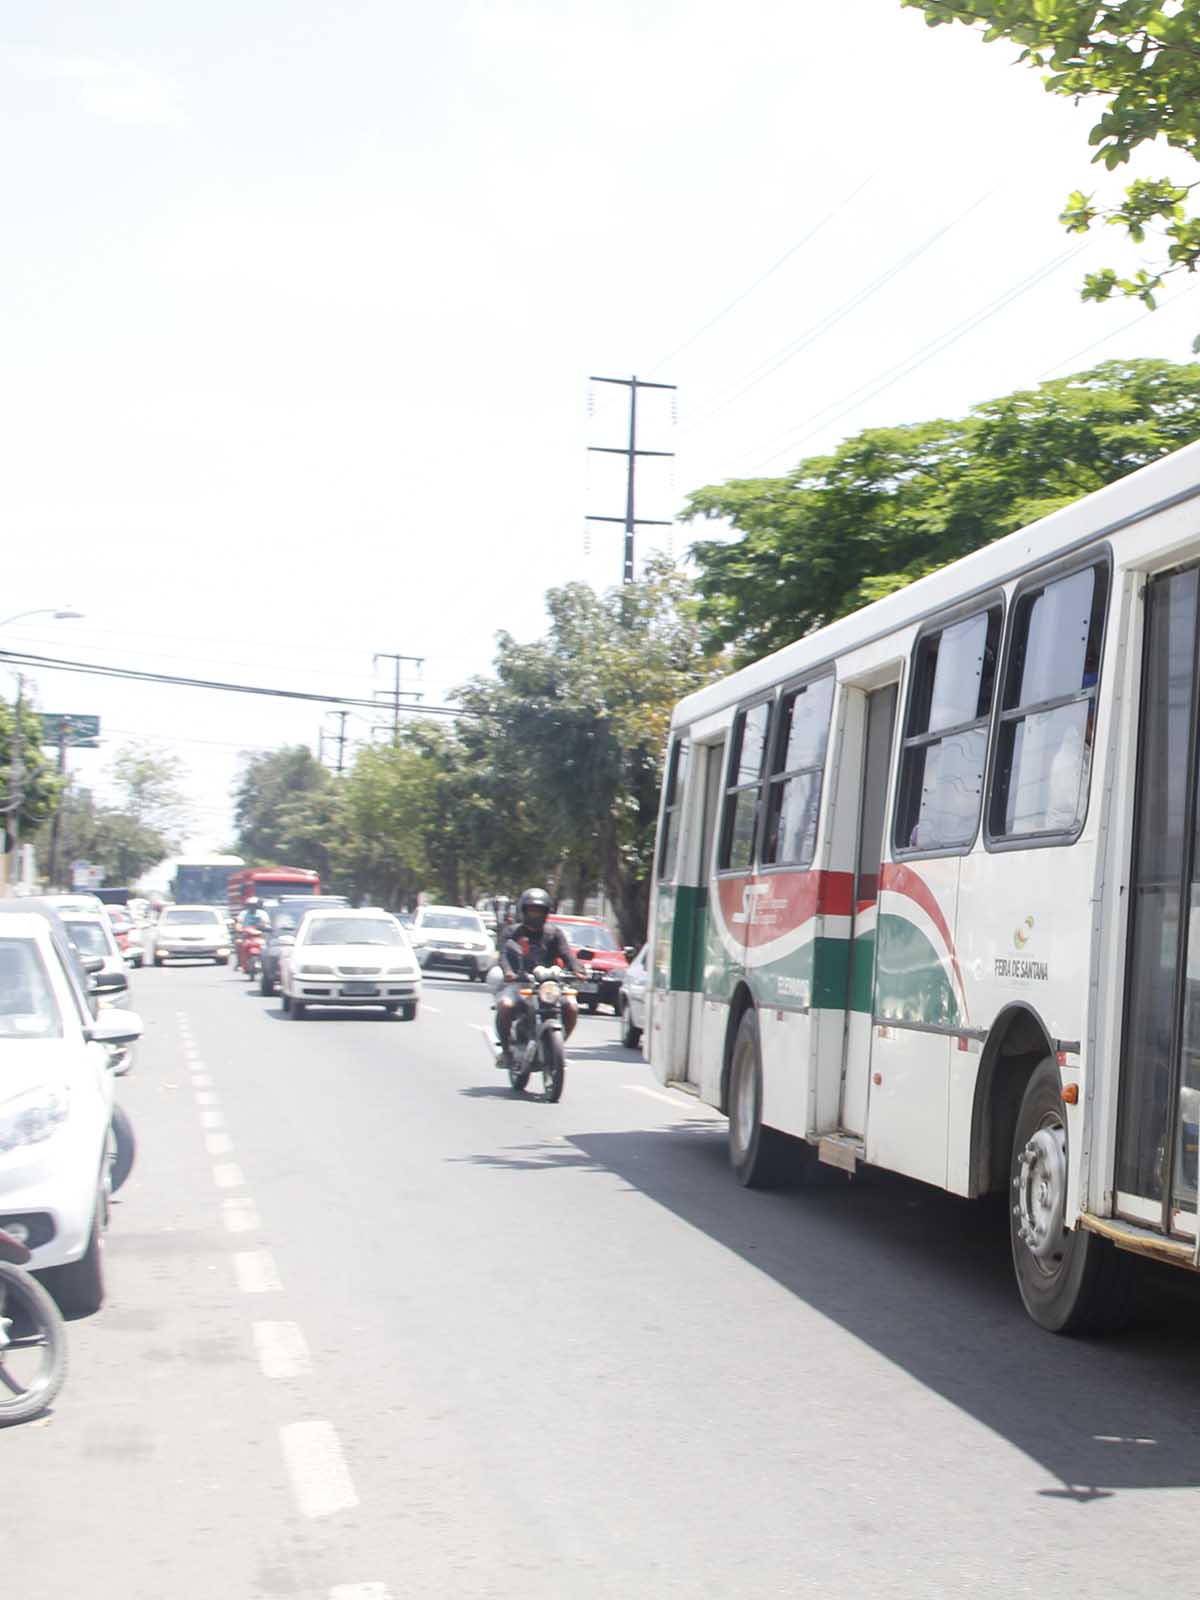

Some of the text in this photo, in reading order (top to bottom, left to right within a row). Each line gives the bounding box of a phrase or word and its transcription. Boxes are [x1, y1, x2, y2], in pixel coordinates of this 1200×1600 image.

[994, 959, 1048, 981] FEIRA DE SANTANA
